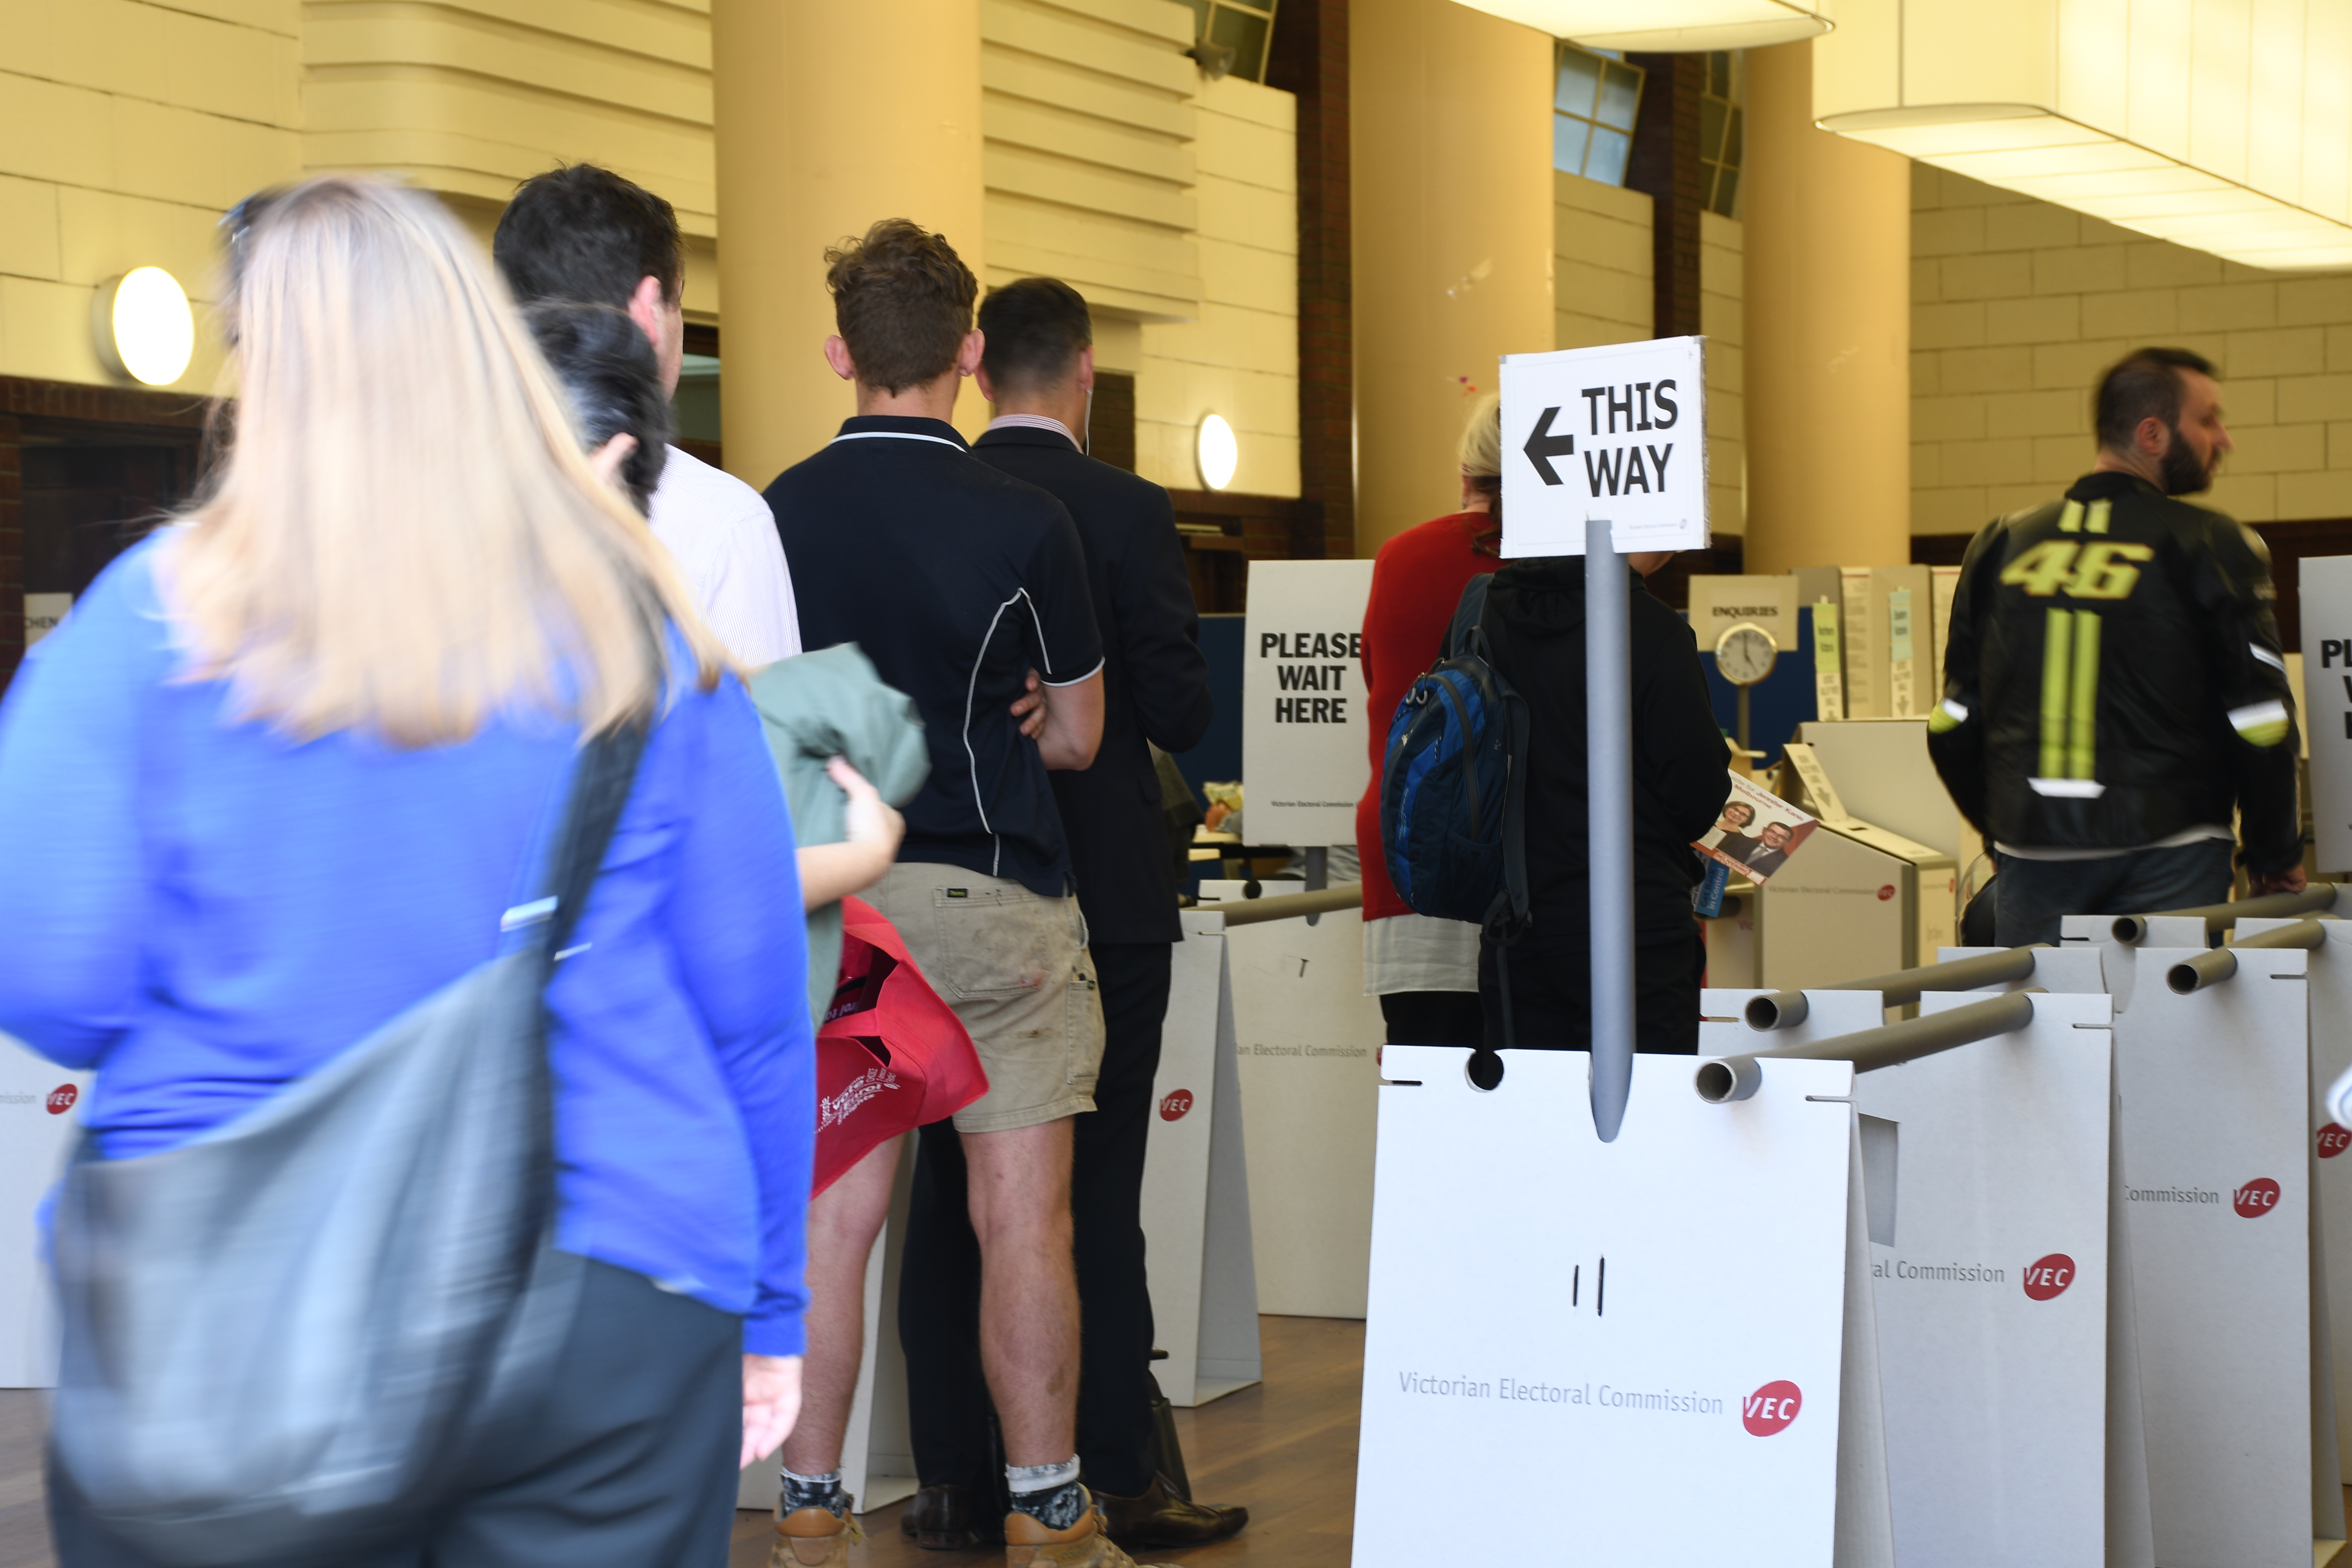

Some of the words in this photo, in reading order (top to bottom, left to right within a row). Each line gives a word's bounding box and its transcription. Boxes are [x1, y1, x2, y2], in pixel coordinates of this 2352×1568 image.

[1582, 379, 1678, 435] THIS
[1584, 443, 1674, 497] WAY
[1999, 539, 2155, 600] 46
[1712, 606, 1778, 619] ENQUIRIES
[1260, 632, 1361, 658] PLEASE
[1277, 665, 1347, 690] WAIT
[1276, 698, 1347, 723] HERE
[1734, 784, 1772, 809] Melbourne
[1711, 868, 1725, 900] Control
[1253, 1044, 1301, 1056] Electoral
[1305, 1044, 1367, 1057] Commission
[1160, 1098, 1189, 1112] VEC
[2234, 1189, 2275, 1206] VEC
[1897, 1260, 2005, 1283] Commission
[2023, 1267, 2069, 1287] VEC
[1399, 1371, 1490, 1398] Victorian
[1500, 1378, 1592, 1405] Electoral
[1599, 1384, 1723, 1415] Commission
[1742, 1396, 1795, 1420] VEC
